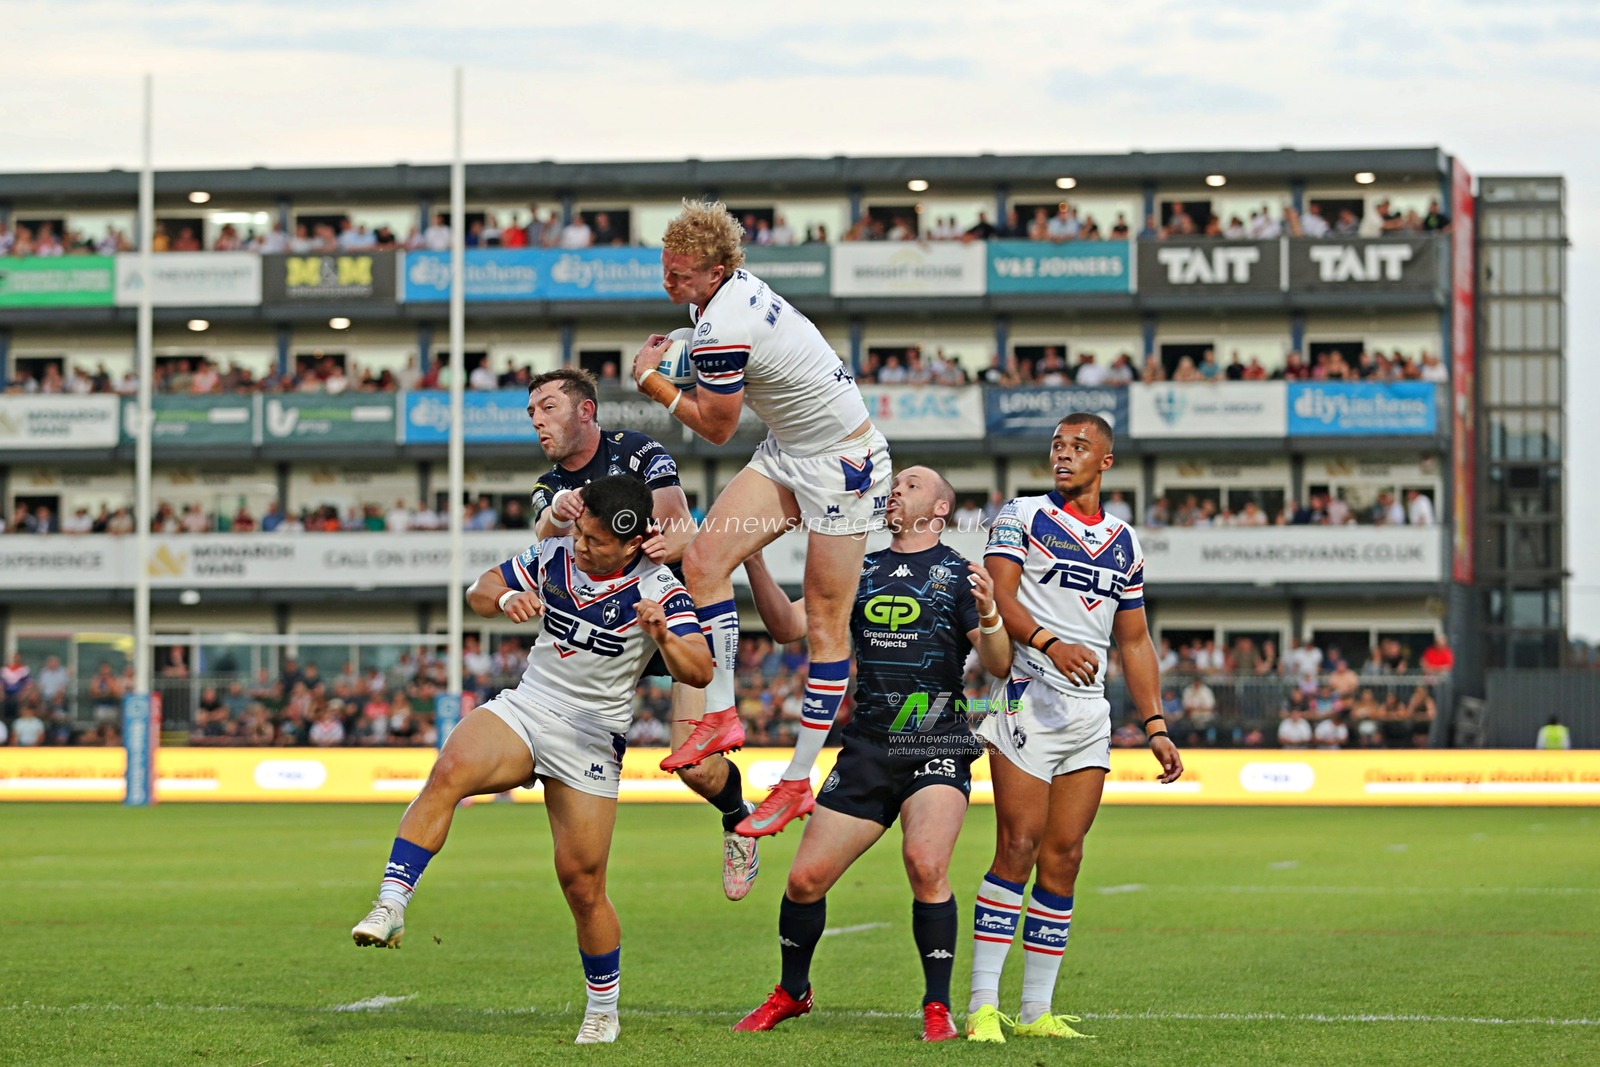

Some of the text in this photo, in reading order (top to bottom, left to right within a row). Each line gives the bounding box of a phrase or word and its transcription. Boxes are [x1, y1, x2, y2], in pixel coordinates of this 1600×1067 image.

[286, 256, 373, 288] M&M
[1157, 247, 1260, 284] TAIT
[1309, 244, 1413, 282] TAIT
[1041, 533, 1082, 552] Prestons
[1038, 562, 1128, 602] ASUS
[544, 609, 628, 658] SUS
[863, 629, 919, 641] Greenmount
[870, 638, 908, 649] Projects
